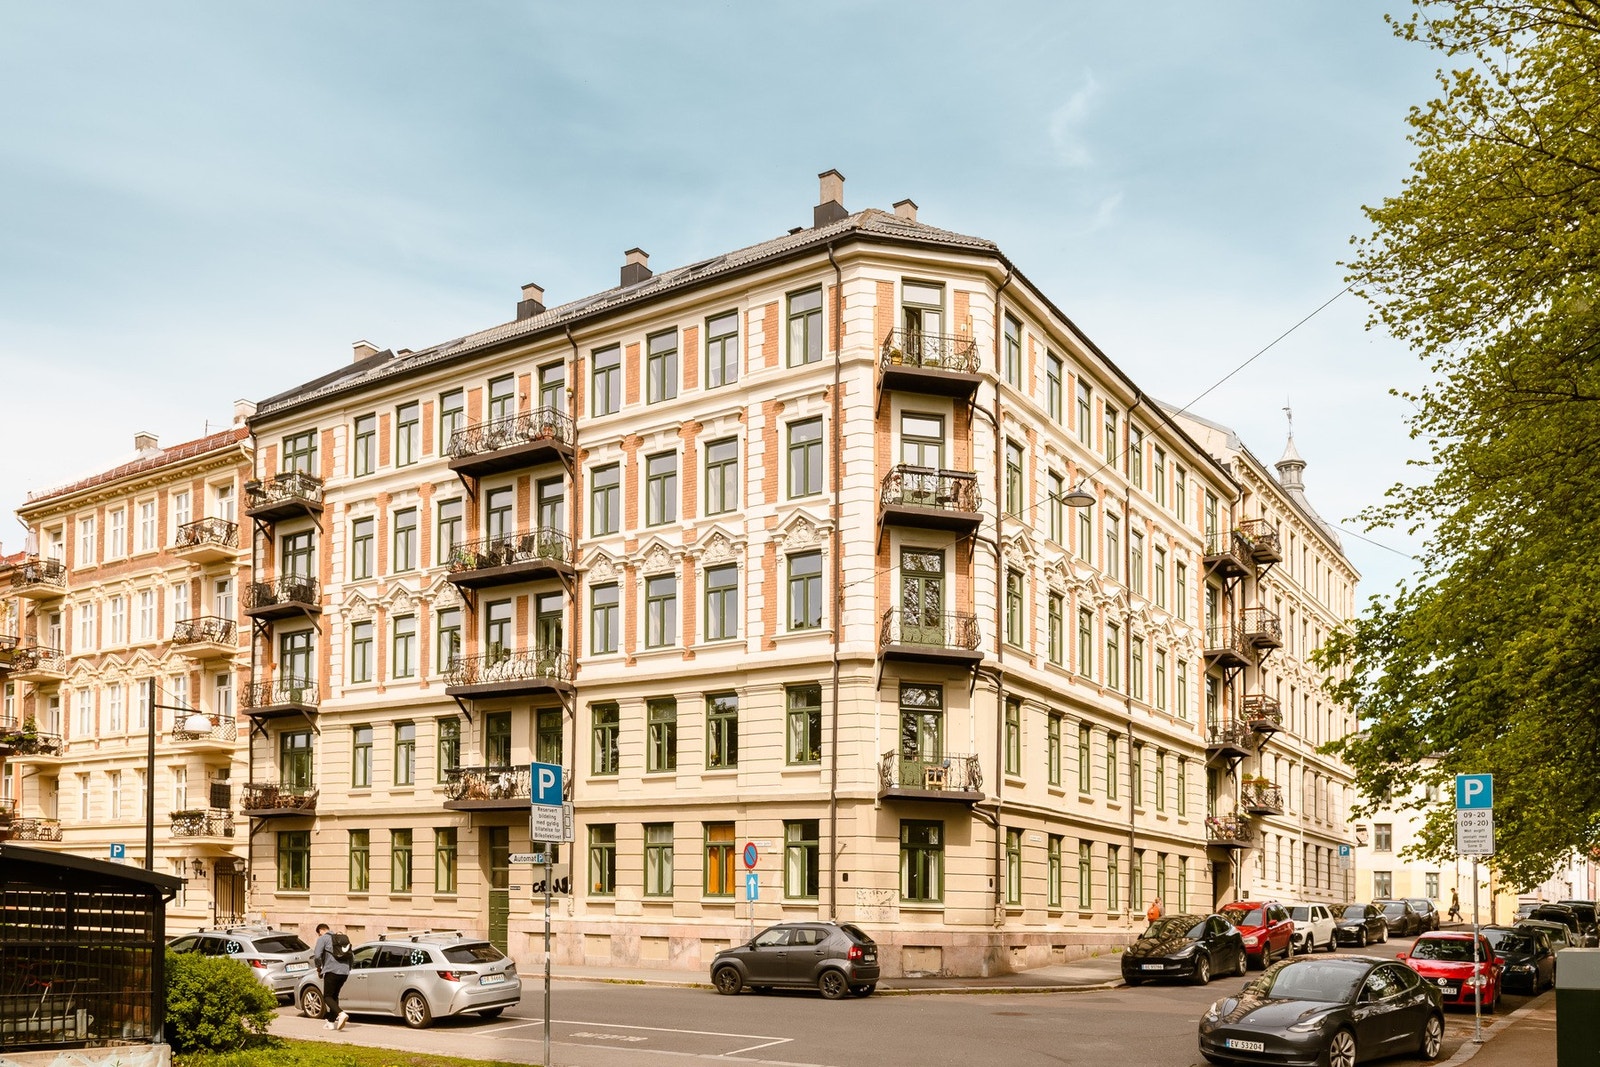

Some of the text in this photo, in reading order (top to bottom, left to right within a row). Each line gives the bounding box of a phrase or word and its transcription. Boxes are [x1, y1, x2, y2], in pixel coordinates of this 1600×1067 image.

[539, 768, 556, 799] P
[1465, 779, 1484, 805] P
[113, 845, 122, 857] P
[1341, 846, 1348, 855] P
[513, 854, 537, 863] Automat
[1241, 1041, 1262, 1050] 53204
